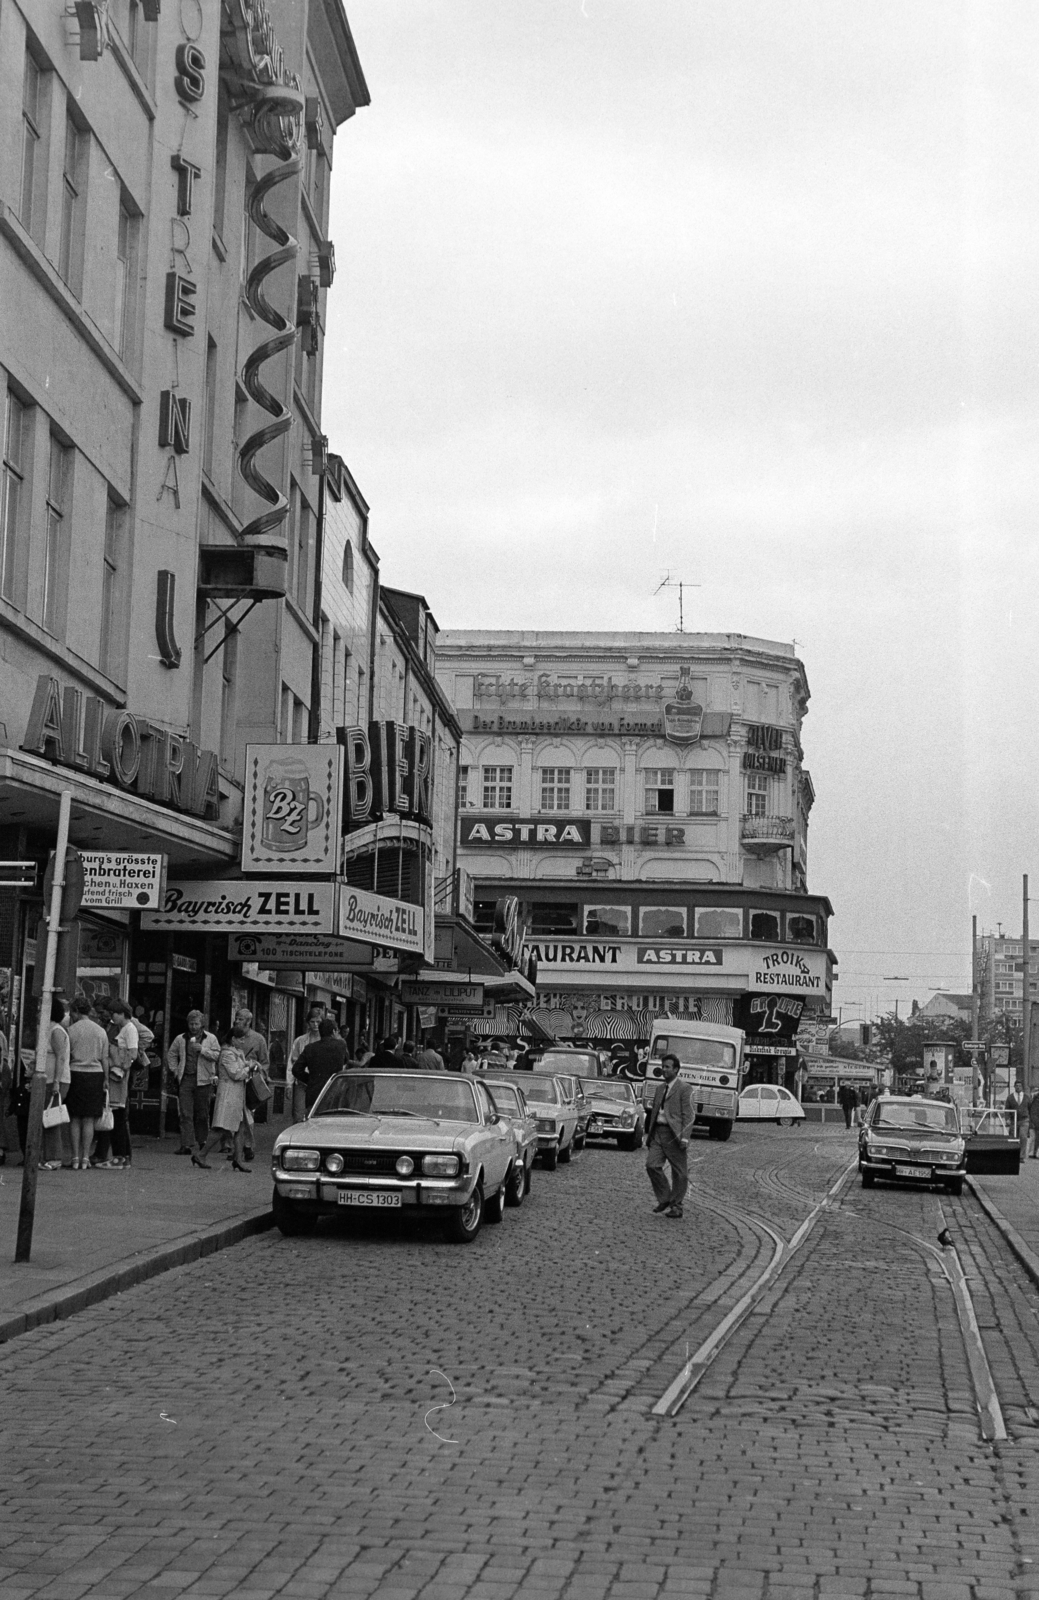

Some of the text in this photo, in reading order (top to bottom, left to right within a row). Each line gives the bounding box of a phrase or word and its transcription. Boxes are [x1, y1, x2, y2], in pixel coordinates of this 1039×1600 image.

[468, 823, 686, 846] ASTRA BIER
[115, 854, 158, 866] grösste
[119, 879, 154, 890] Haxen
[84, 896, 123, 905] vom Grill
[108, 889, 133, 898] frisch
[163, 888, 320, 919] Bayrisch ZELL
[346, 894, 418, 937] Bayrisch ZELL
[260, 947, 345, 958] 100 TISCHTELEFONE
[643, 949, 717, 964] ASTRA
[762, 950, 811, 975] TROIKA
[755, 971, 822, 988] RESTAURANT
[407, 986, 431, 997] TANZ
[443, 987, 478, 998] LILIPUT
[339, 1192, 400, 1206] HH-CS 1303
